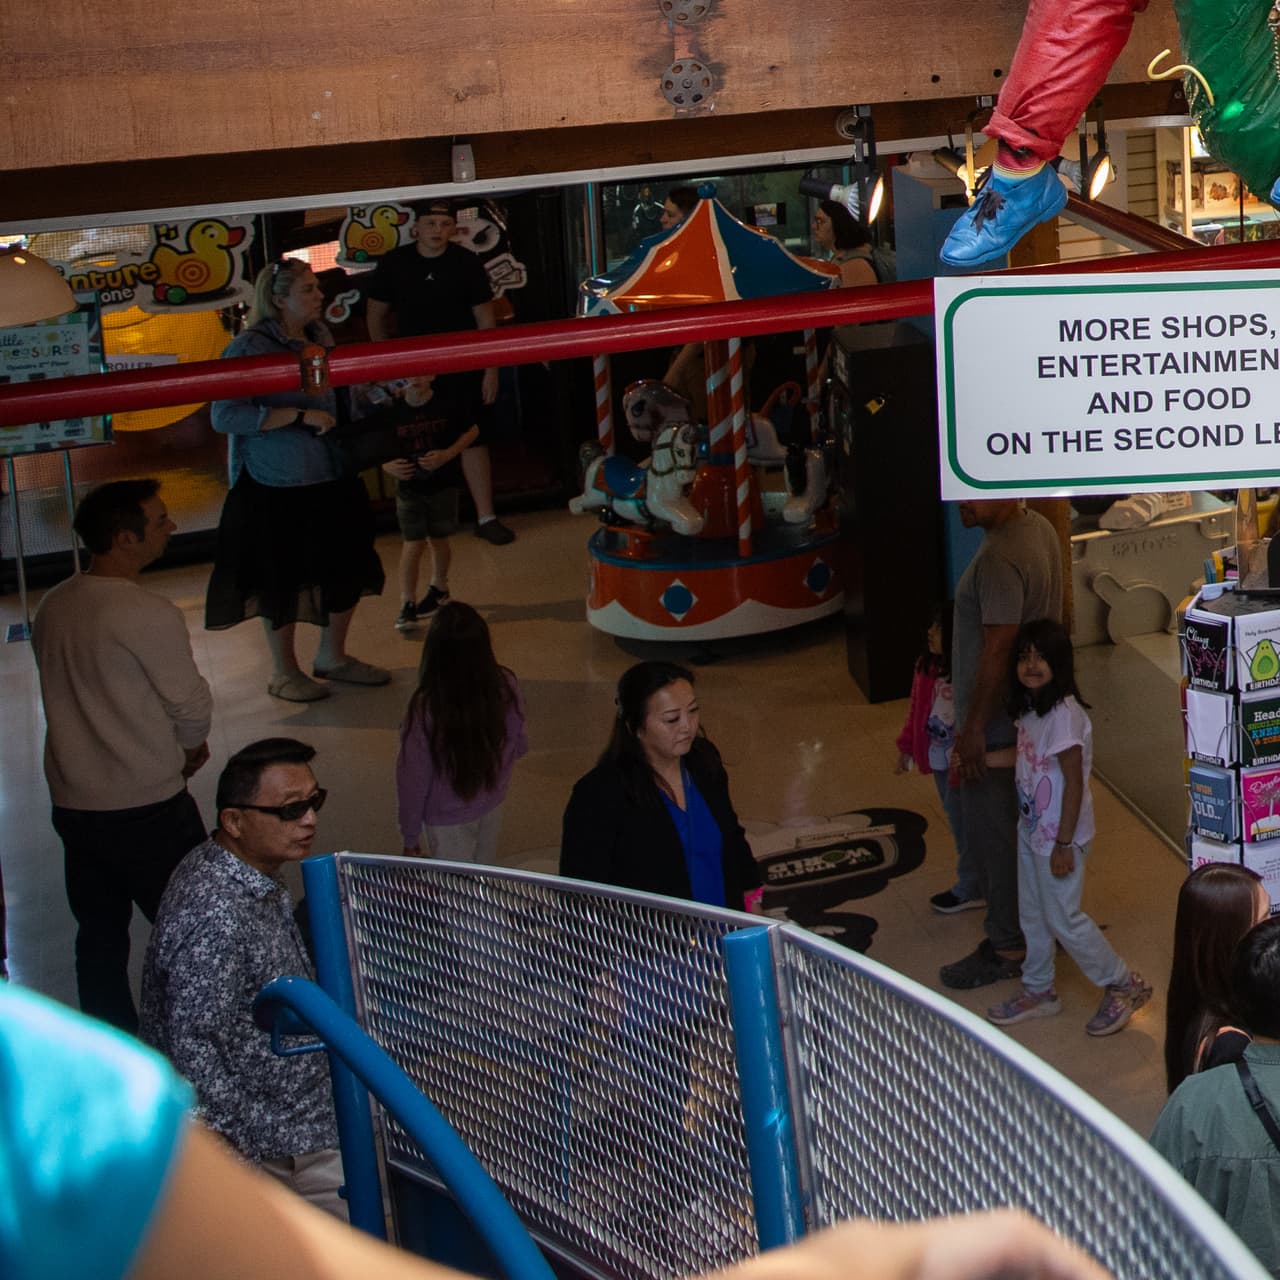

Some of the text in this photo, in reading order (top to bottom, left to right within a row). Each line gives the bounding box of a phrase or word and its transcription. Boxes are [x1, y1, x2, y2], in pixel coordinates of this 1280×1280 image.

[70, 260, 159, 291] nture
[100, 287, 135, 304] one
[1058, 313, 1277, 342] MORE SHOPS,
[1087, 386, 1251, 414] AND FOOD
[986, 430, 1031, 455] ON
[1042, 428, 1103, 453] THE
[1113, 423, 1245, 452] SECOND
